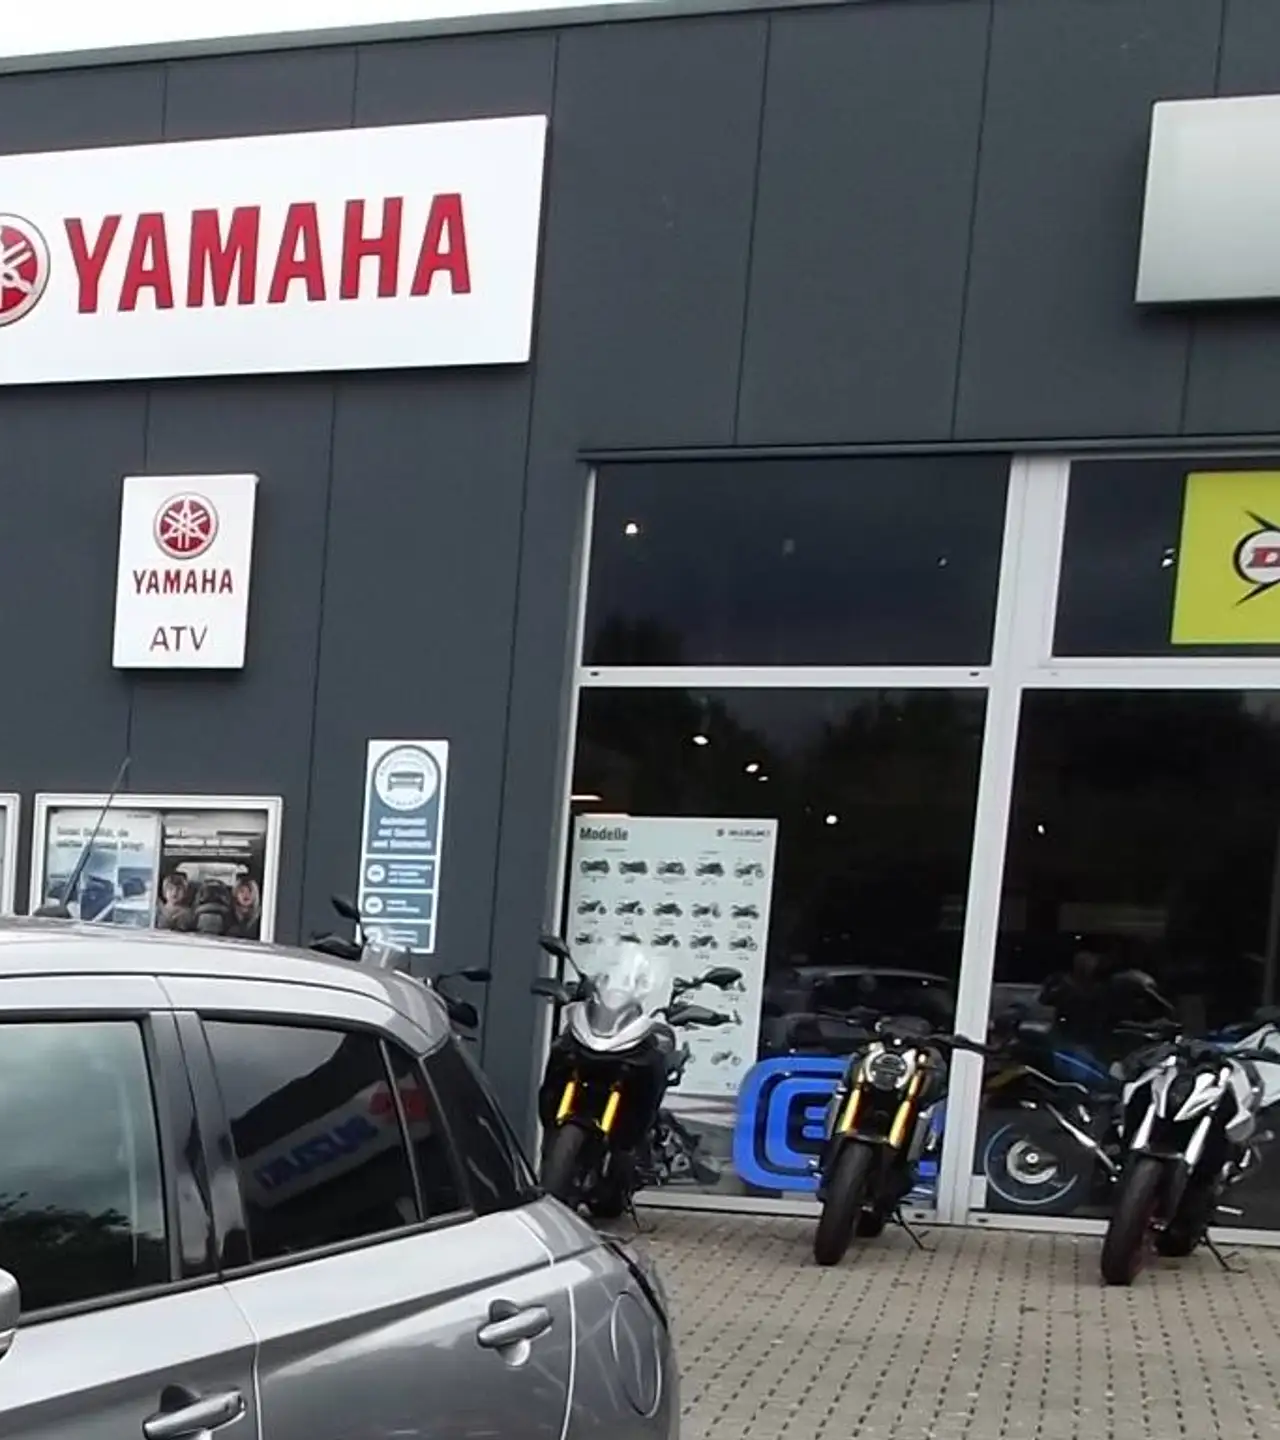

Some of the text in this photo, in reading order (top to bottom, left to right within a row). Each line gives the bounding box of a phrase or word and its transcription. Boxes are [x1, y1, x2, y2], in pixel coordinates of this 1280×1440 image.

[64, 193, 472, 314] YAMAHA
[132, 568, 234, 595] YAMAHA
[148, 625, 209, 652] ATV
[579, 826, 629, 841] Modelle
